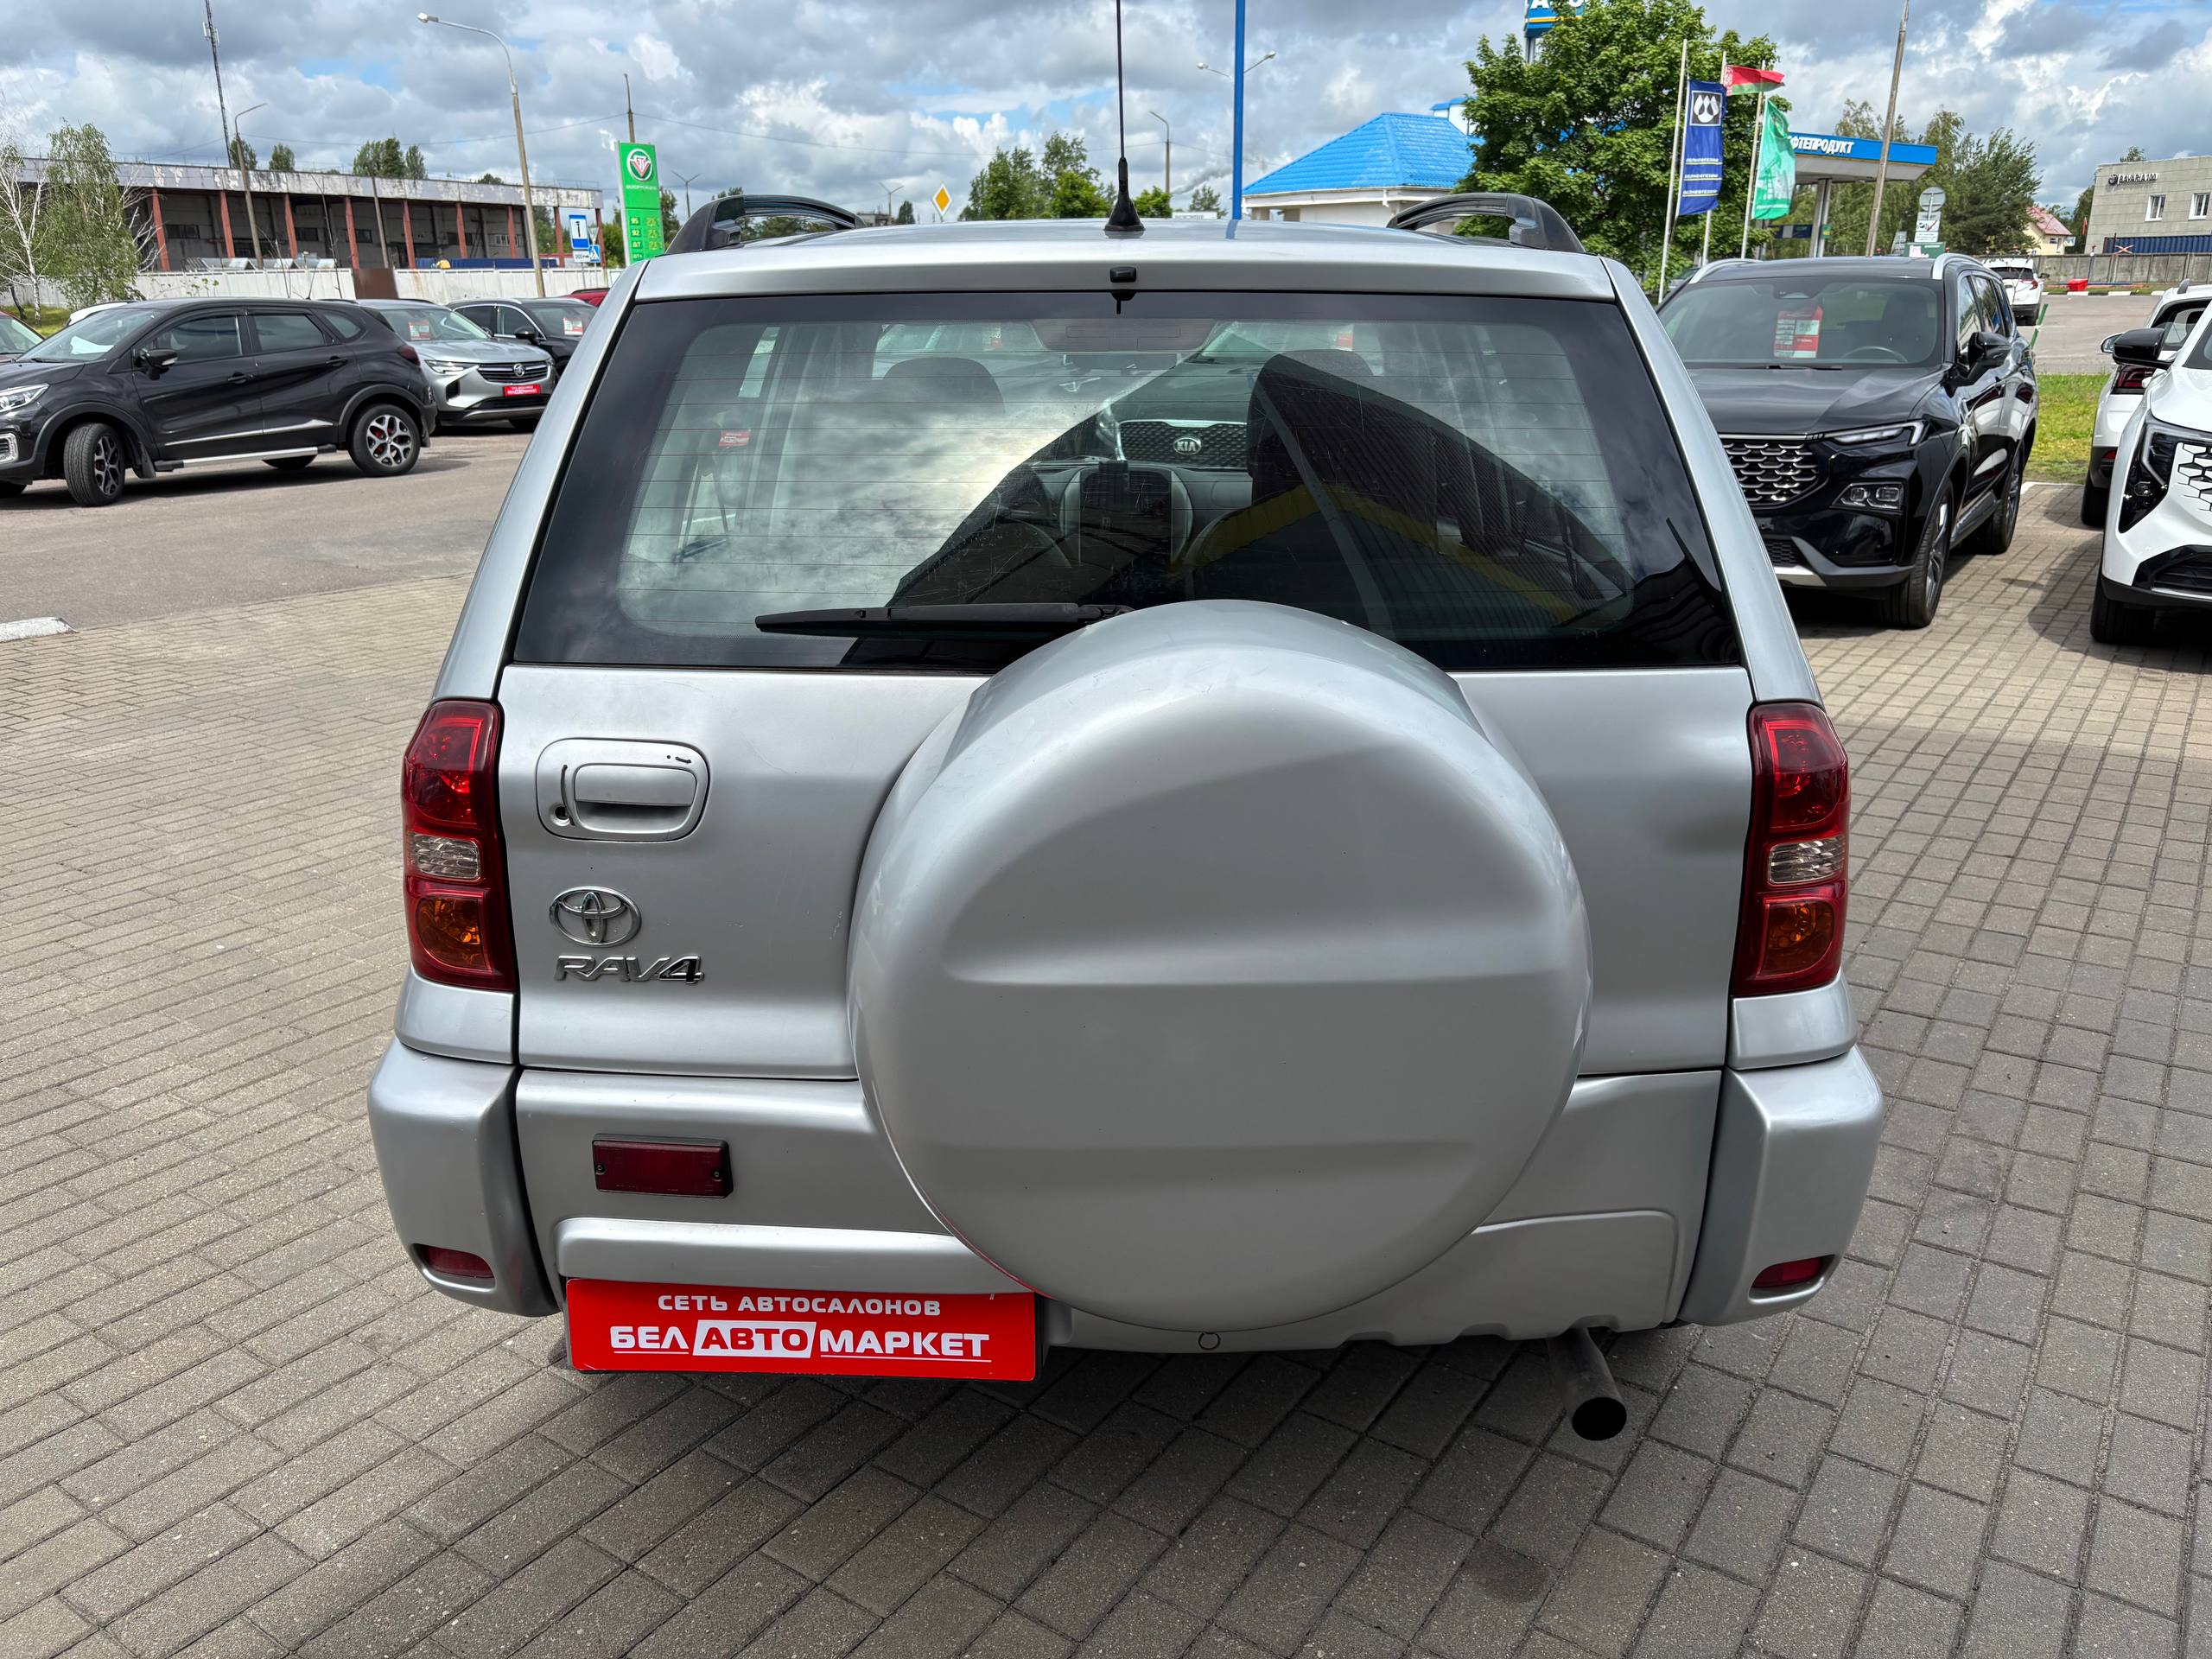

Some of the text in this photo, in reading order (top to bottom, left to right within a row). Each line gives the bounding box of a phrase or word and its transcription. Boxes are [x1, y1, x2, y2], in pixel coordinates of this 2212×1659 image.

[1177, 441, 1197, 452] KIA
[553, 955, 705, 984] RAV4
[658, 1294, 941, 1317] СЕТЬ АВТОСАЛОНОВ
